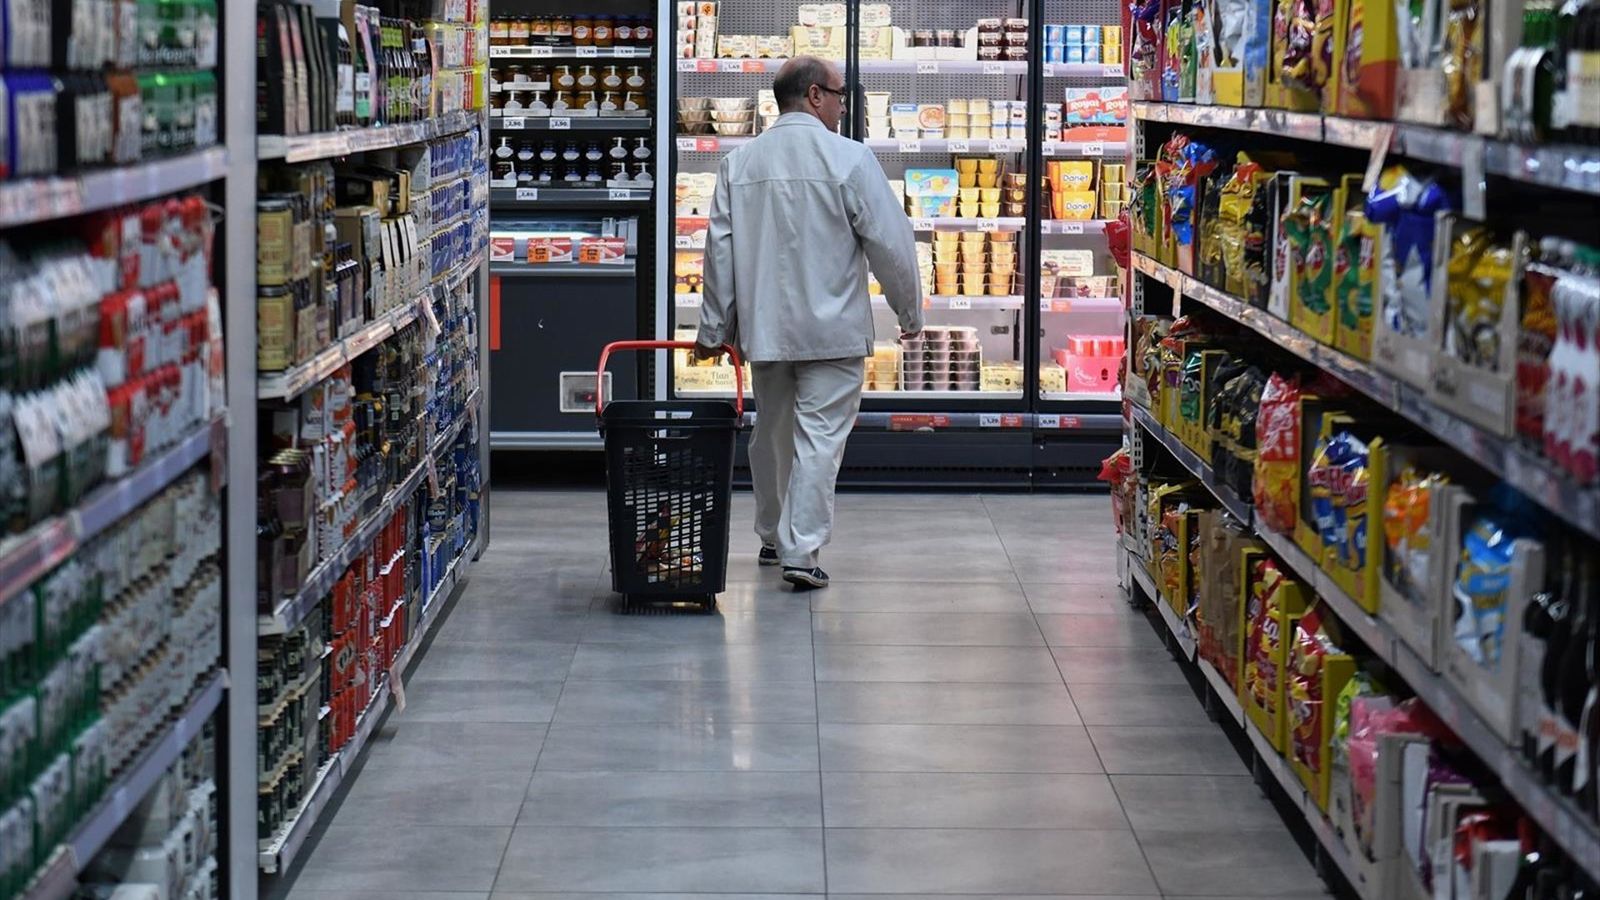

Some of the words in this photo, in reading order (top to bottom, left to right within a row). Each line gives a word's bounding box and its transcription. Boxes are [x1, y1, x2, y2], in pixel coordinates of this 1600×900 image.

[1071, 100, 1099, 111] Royal
[1063, 174, 1088, 182] Danet
[1066, 202, 1091, 210] Danet
[711, 371, 729, 380] Flan
